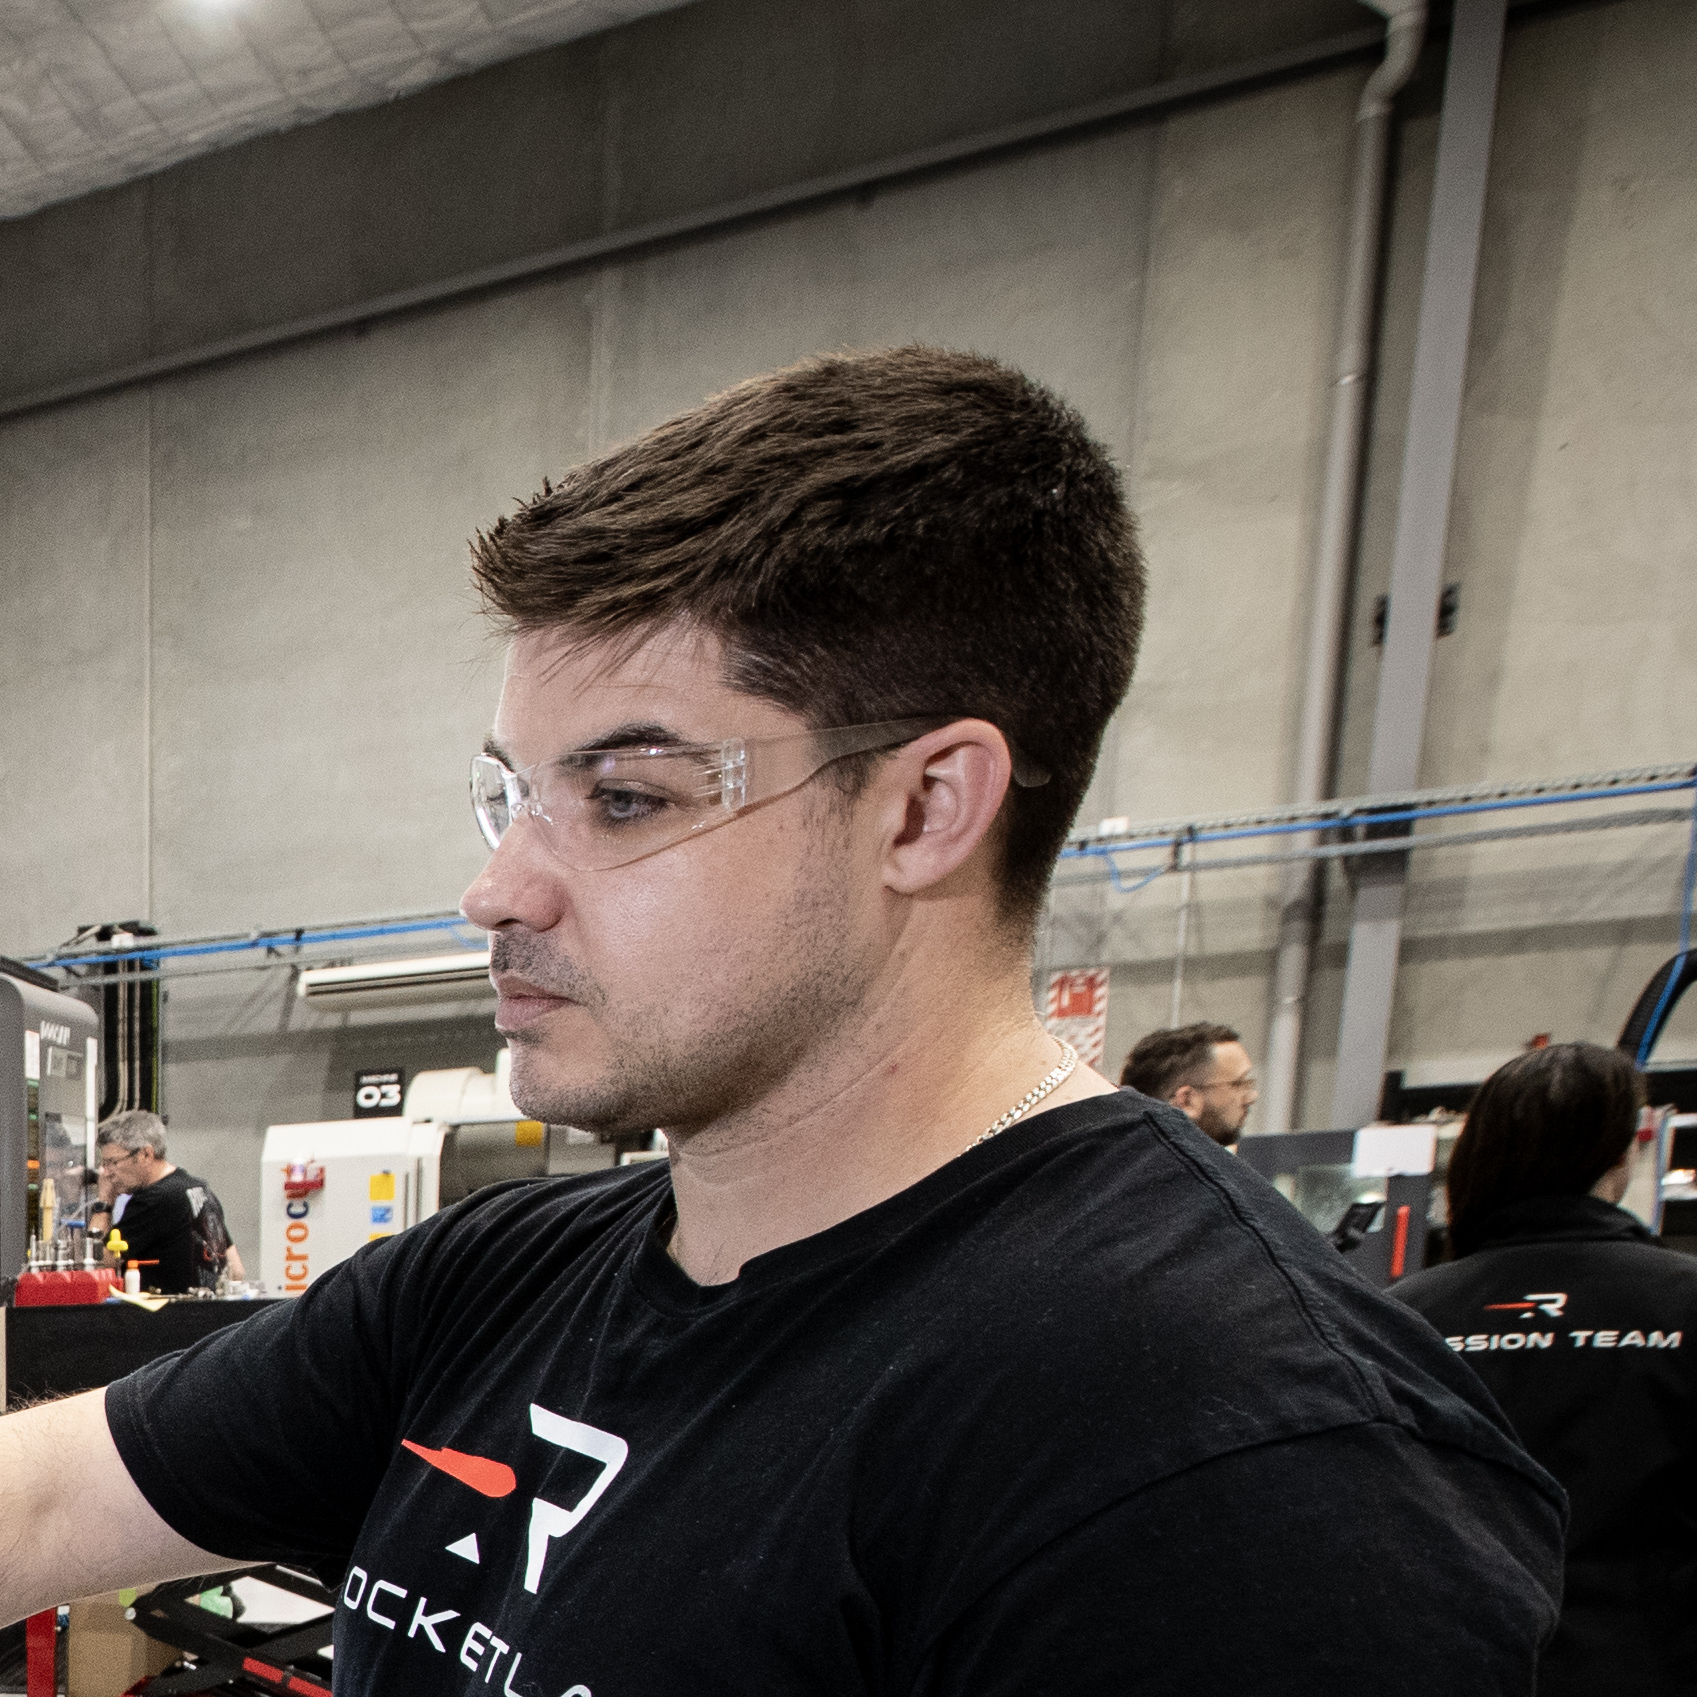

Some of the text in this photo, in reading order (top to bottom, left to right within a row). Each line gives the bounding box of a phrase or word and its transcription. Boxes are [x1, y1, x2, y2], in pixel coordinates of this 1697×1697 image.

[356, 1084, 401, 1108] 03
[1445, 1330, 1683, 1352] SSION TEAM
